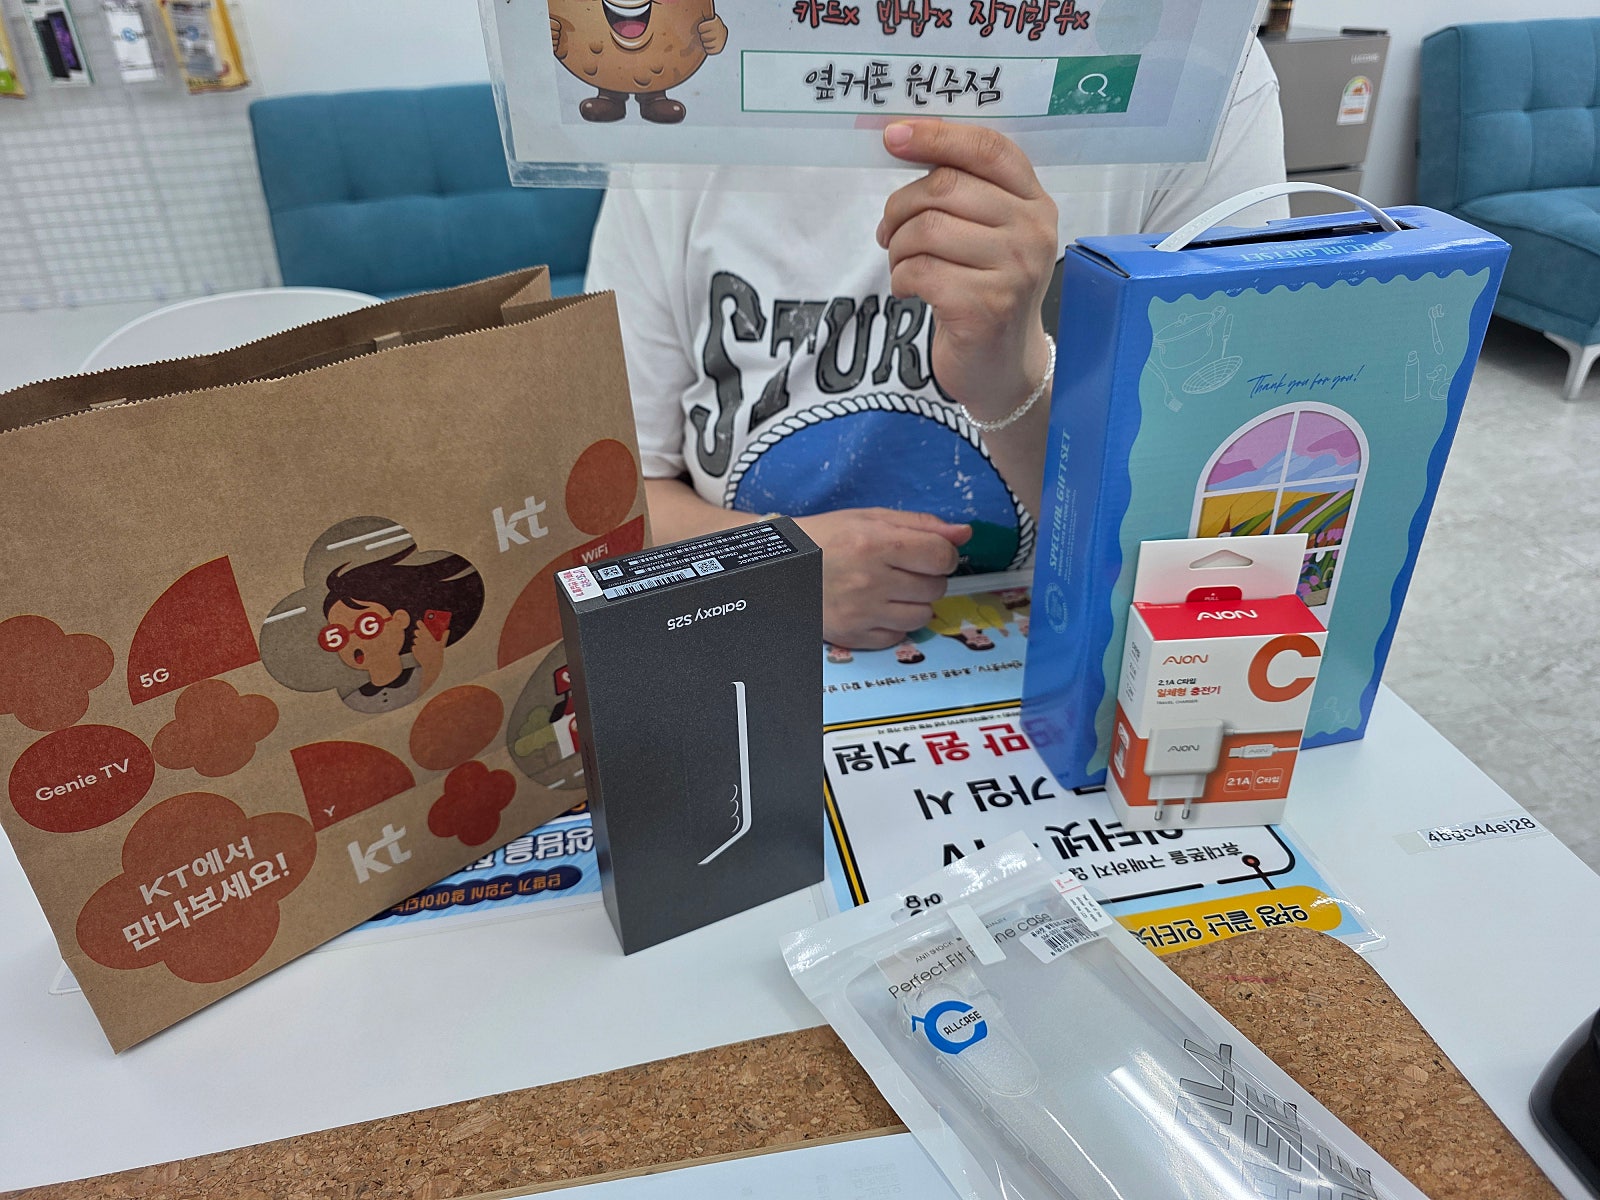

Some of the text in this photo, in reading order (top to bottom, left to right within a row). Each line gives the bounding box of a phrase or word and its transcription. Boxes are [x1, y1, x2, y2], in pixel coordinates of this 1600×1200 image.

[804, 60, 1001, 107] 옆커폰 원주점
[689, 270, 958, 478] STUR
[1247, 373, 1286, 398] Thank
[1286, 378, 1309, 396] you
[1308, 374, 1331, 395] for
[492, 496, 549, 553] kt
[581, 543, 609, 564] WiFi
[667, 599, 747, 631] Galaxy S25
[139, 667, 170, 688] 5G
[1247, 633, 1322, 703] C
[1190, 685, 1222, 696] 충전기
[832, 723, 1031, 775] 만 원 지원
[35, 758, 131, 802] Genie TV
[1256, 775, 1281, 785] C타입
[913, 775, 1056, 820] 가입 시
[323, 804, 336, 819] Y
[346, 823, 413, 884] kt
[1091, 853, 1166, 879] 구매하지
[1170, 841, 1244, 866] 휴대폰을
[138, 835, 256, 906] KT에서
[518, 873, 561, 892] 단말기
[121, 852, 292, 953] 만나보세요!
[471, 881, 513, 901] 구입시
[1203, 909, 1253, 936] 끝난
[1255, 902, 1310, 928] 약정
[888, 960, 948, 999] Perfect
[945, 950, 967, 968] Fit
[1017, 912, 1052, 932] case
[943, 1009, 983, 1036] ALLCASE
